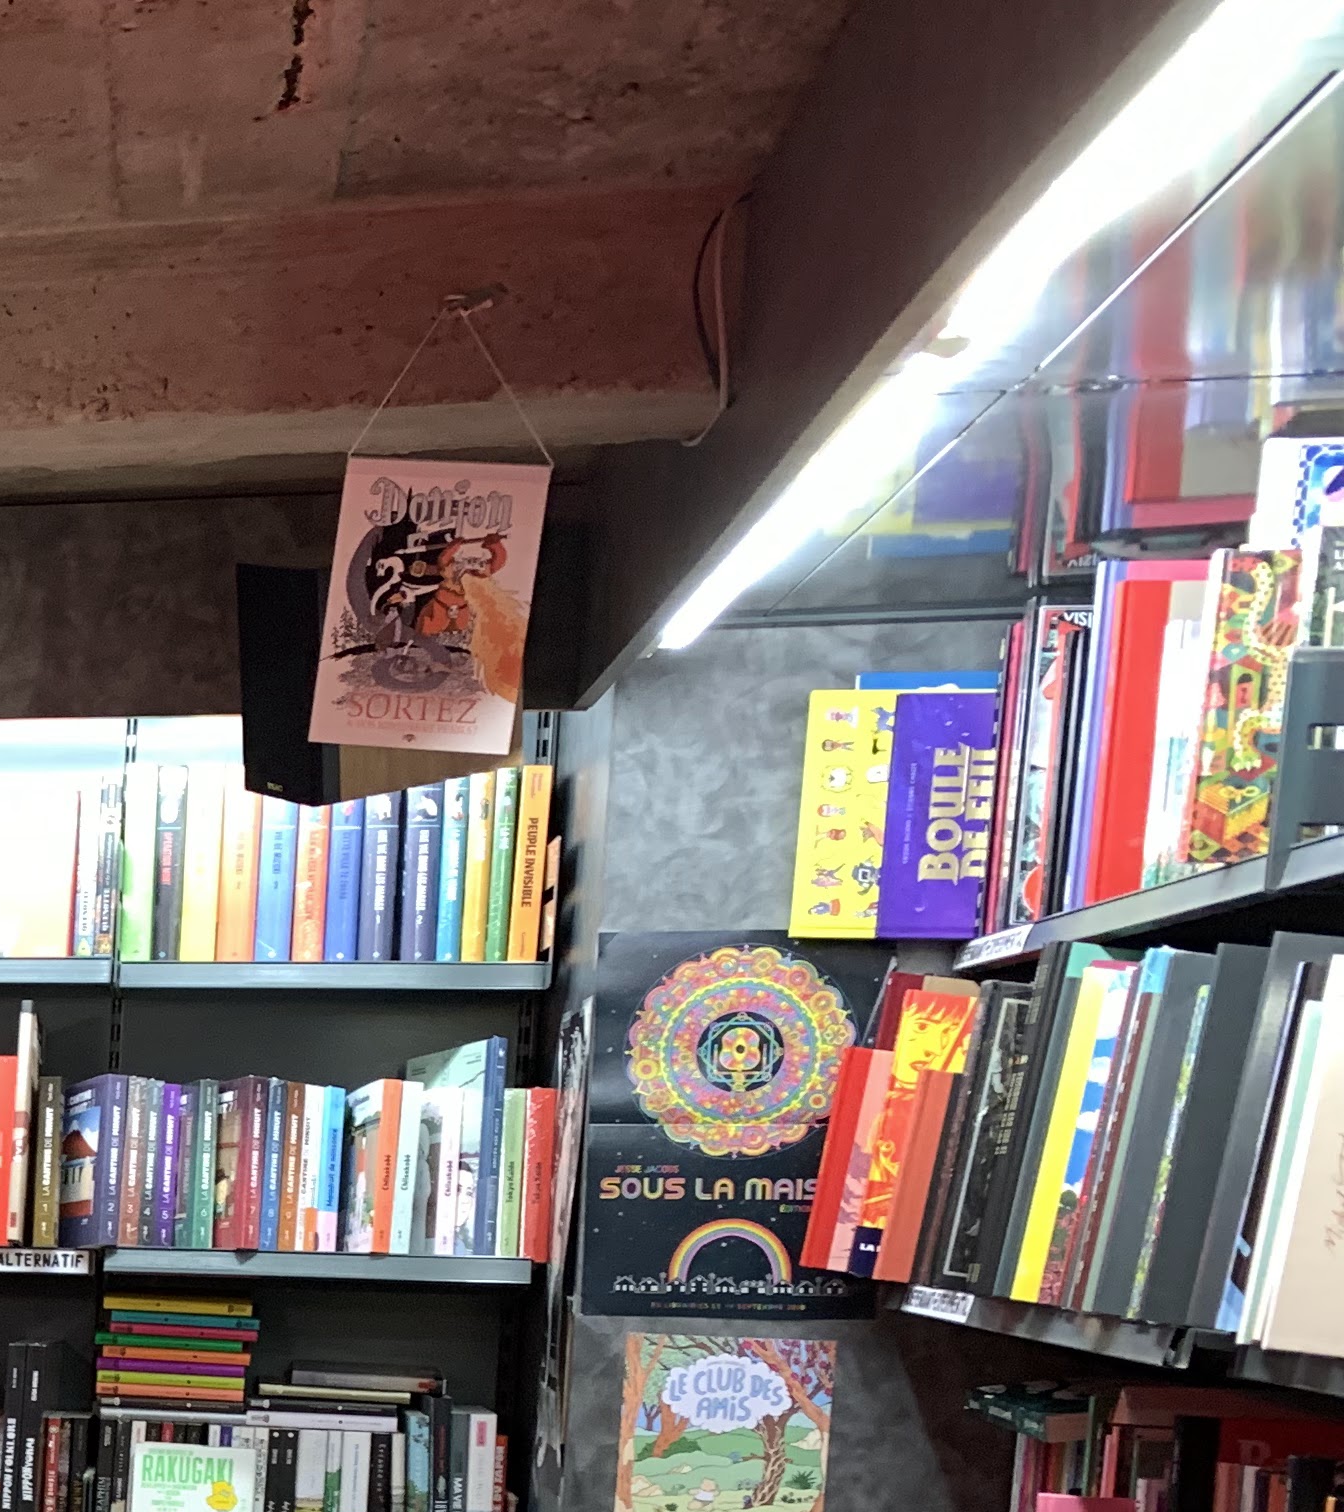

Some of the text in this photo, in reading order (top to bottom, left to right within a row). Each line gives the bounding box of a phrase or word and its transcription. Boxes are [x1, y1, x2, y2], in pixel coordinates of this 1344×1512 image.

[365, 477, 513, 537] Donjon
[346, 691, 477, 725] SORTEZ
[917, 742, 970, 886] BOULE
[599, 1177, 734, 1200] SOUS LA
[668, 1367, 786, 1407] LE CLUB DES
[142, 1455, 234, 1484] RAKUGAKI
